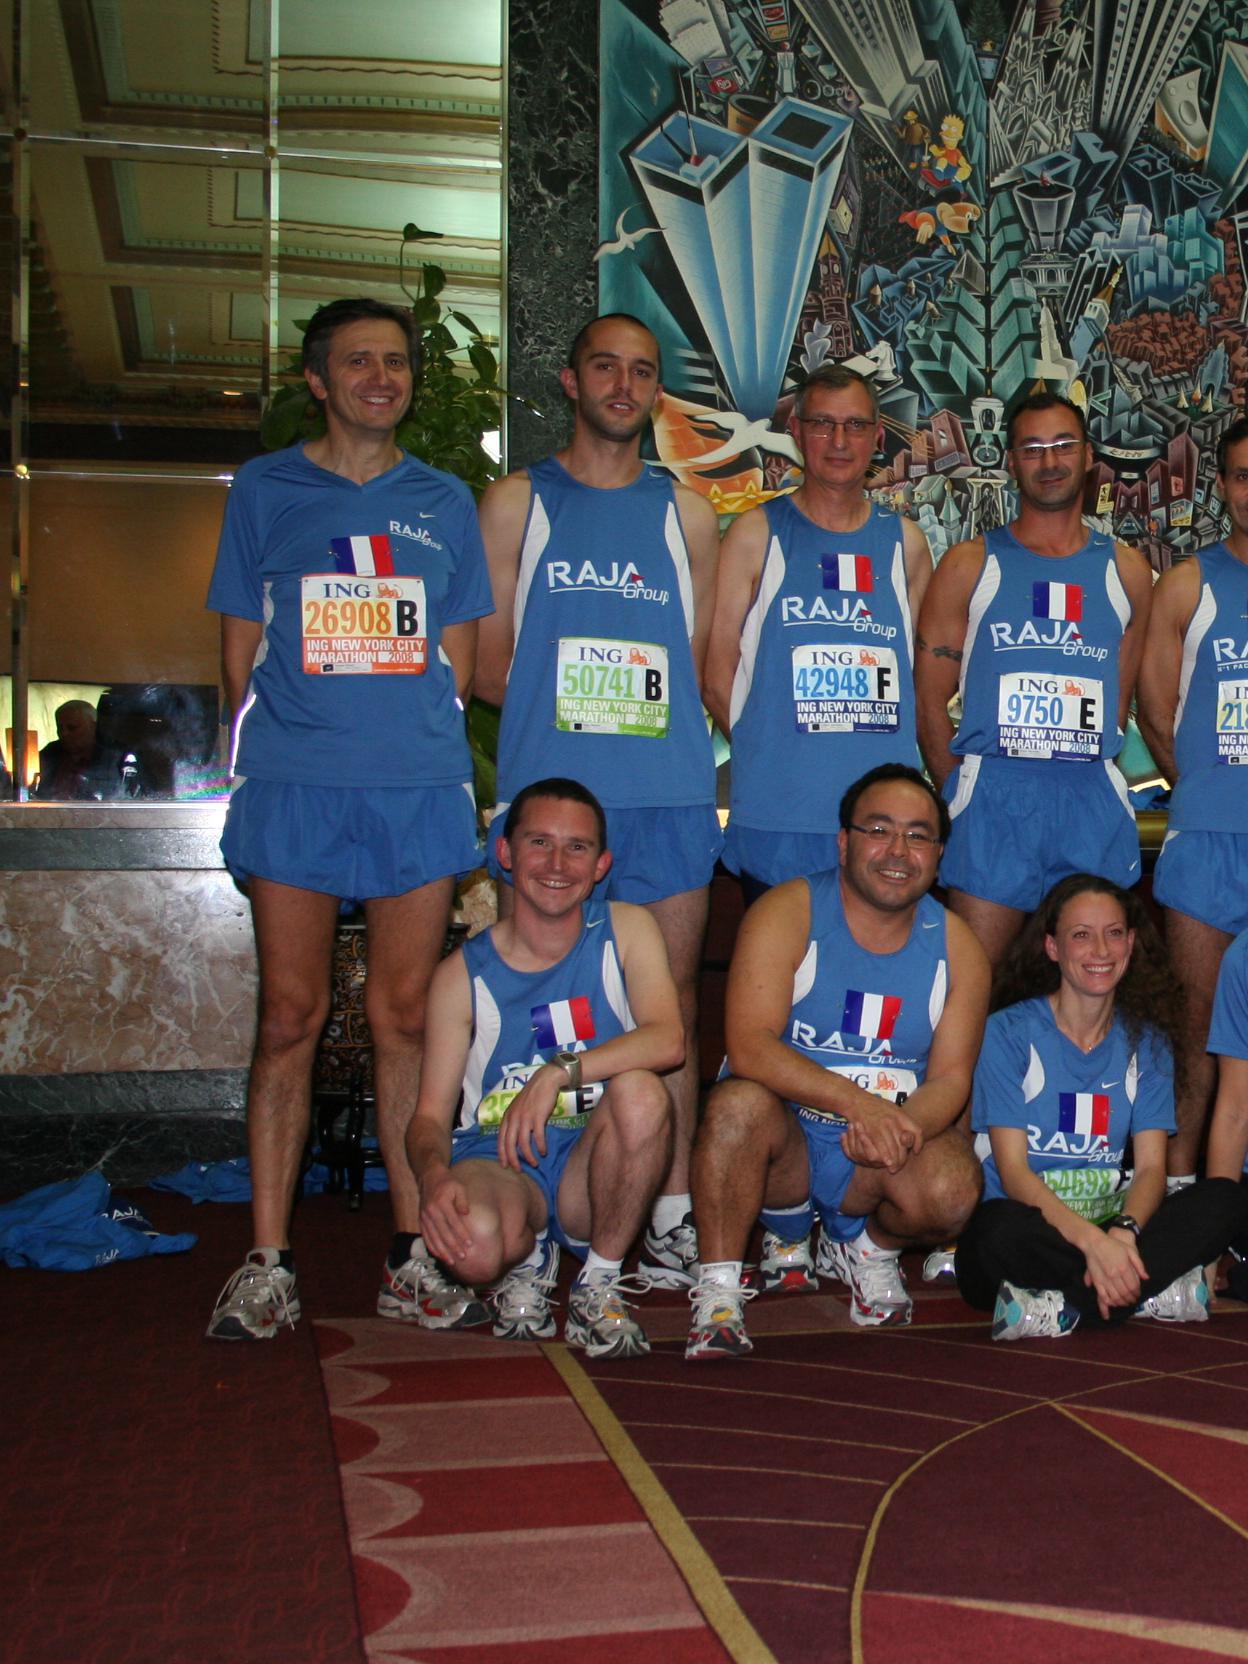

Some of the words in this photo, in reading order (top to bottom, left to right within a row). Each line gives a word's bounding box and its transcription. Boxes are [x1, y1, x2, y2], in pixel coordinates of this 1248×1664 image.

[389, 520, 431, 541] RAJA
[547, 560, 644, 587] RAJA
[323, 583, 371, 598] ING
[624, 584, 669, 605] Group
[305, 601, 392, 635] 26908
[397, 600, 418, 636] B
[782, 596, 872, 621] RAJA
[854, 618, 896, 640] Group
[990, 621, 1083, 646] RAJA
[307, 640, 328, 650] ING
[332, 640, 360, 650] NEW
[364, 640, 394, 650] YORK
[397, 640, 423, 650] CITY
[1063, 641, 1108, 662] Group
[308, 652, 377, 663] MARATHON
[579, 647, 623, 663] ING
[811, 652, 853, 665] ING
[563, 664, 635, 698] 50741
[645, 669, 662, 701] B
[796, 668, 868, 698] 42948
[877, 667, 891, 700] F
[1018, 679, 1059, 694] ING
[560, 699, 580, 710] ING
[584, 700, 610, 711] NEW
[613, 702, 641, 713] YORK
[644, 705, 666, 716] CITY
[560, 711, 625, 723] MARATHON
[797, 702, 816, 712] ING
[820, 702, 844, 712] NEW
[846, 702, 873, 713] YORK
[875, 704, 897, 714] CITY
[1008, 694, 1063, 726] 9750
[1080, 698, 1096, 730] E
[798, 713, 858, 723] MARATHON
[1000, 726, 1018, 738] ING
[1021, 728, 1047, 739] NEW
[1049, 730, 1075, 741] YORK
[1078, 733, 1100, 744] CITY
[1000, 738, 1059, 751] MARATHON
[1219, 735, 1236, 745] ING
[792, 1020, 893, 1056] RAJA
[1027, 1124, 1112, 1154] RAJA
